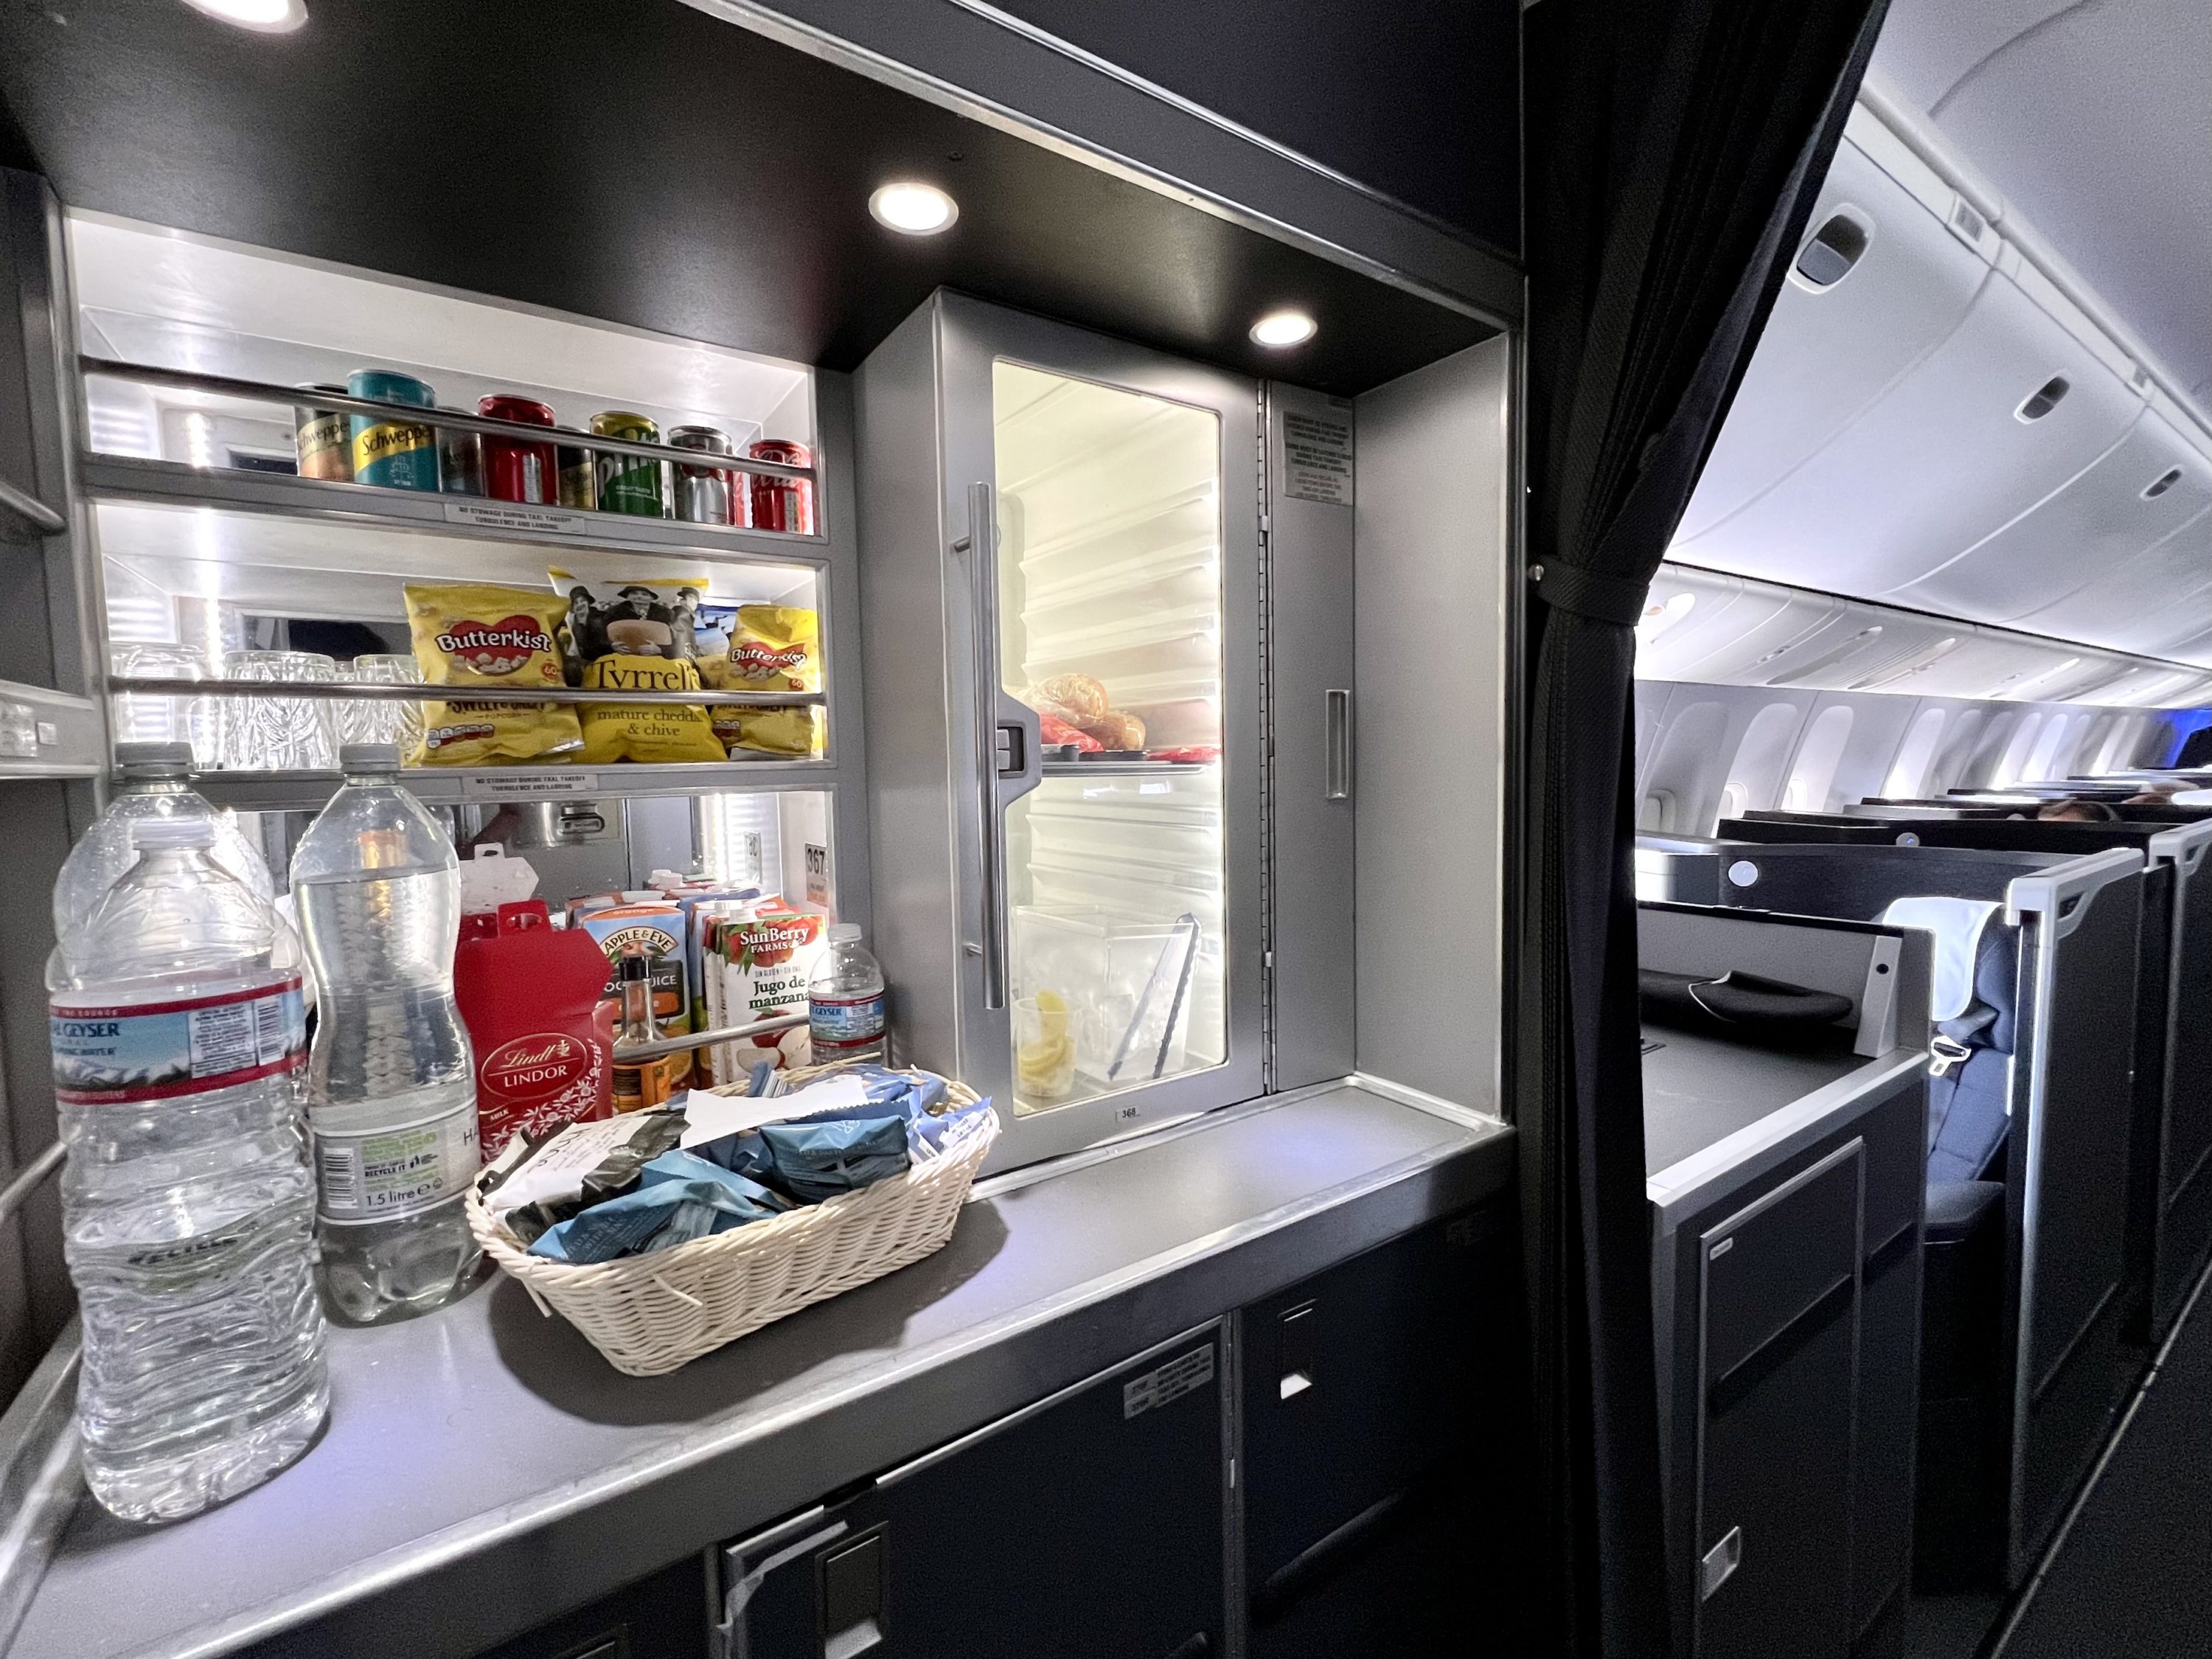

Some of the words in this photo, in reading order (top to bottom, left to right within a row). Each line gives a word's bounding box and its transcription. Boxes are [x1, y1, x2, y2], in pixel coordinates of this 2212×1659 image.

[299, 421, 350, 450] chweppe
[362, 425, 431, 455] Schweppe
[470, 507, 501, 516] STOWAGE
[504, 511, 527, 519] DURING
[475, 516, 515, 526] TURBULENCE
[434, 628, 552, 653] Butterkist
[544, 665, 557, 675] 60
[597, 710, 650, 720] mature
[654, 709, 703, 723] chedda
[627, 723, 639, 734] &
[644, 723, 680, 736] chive
[807, 847, 825, 875] 367
[604, 929, 640, 956] APPLE
[650, 930, 672, 950] EVE
[751, 941, 788, 953] FARMS
[754, 980, 786, 996] Jugo
[789, 975, 805, 988] de
[749, 992, 810, 1009] manzana
[815, 1007, 842, 1016] GEYSER
[63, 1022, 121, 1037] GEYSER
[499, 1044, 557, 1068] Lindt
[504, 1065, 568, 1088] LINDOR
[490, 1108, 509, 1121] MILK
[1122, 1107, 1136, 1118] 368
[364, 1167, 397, 1178] RECYCLE
[398, 1164, 406, 1172] IT
[366, 1193, 386, 1206] 1.5
[389, 1189, 415, 1203] litre
